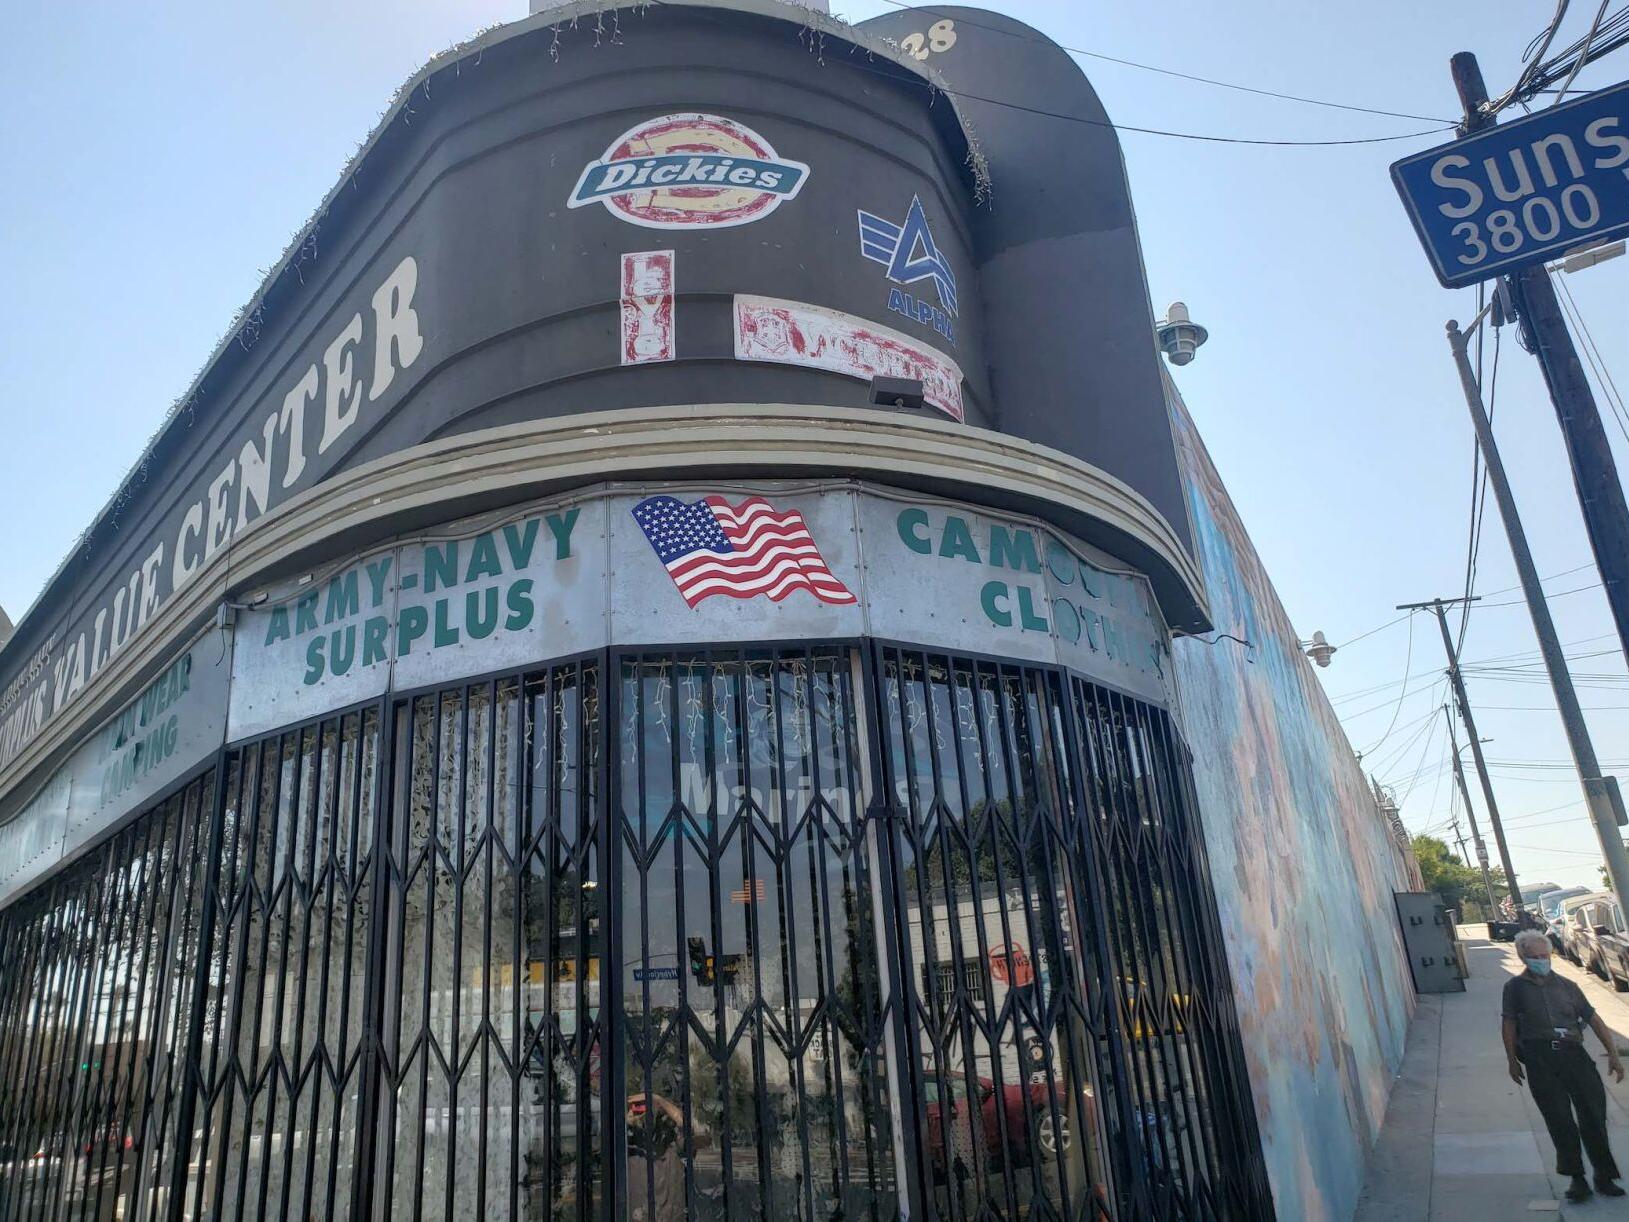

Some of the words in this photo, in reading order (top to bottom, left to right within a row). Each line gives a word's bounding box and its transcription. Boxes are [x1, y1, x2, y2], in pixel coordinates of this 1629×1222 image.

[594, 157, 783, 192] Dickies
[1450, 183, 1601, 265] 3800
[888, 288, 957, 348] ALPHA
[53, 540, 164, 714] VALUE
[172, 256, 424, 592] CENTER
[264, 508, 582, 647] ARMY-NAVY
[303, 578, 535, 687] SURPLUS
